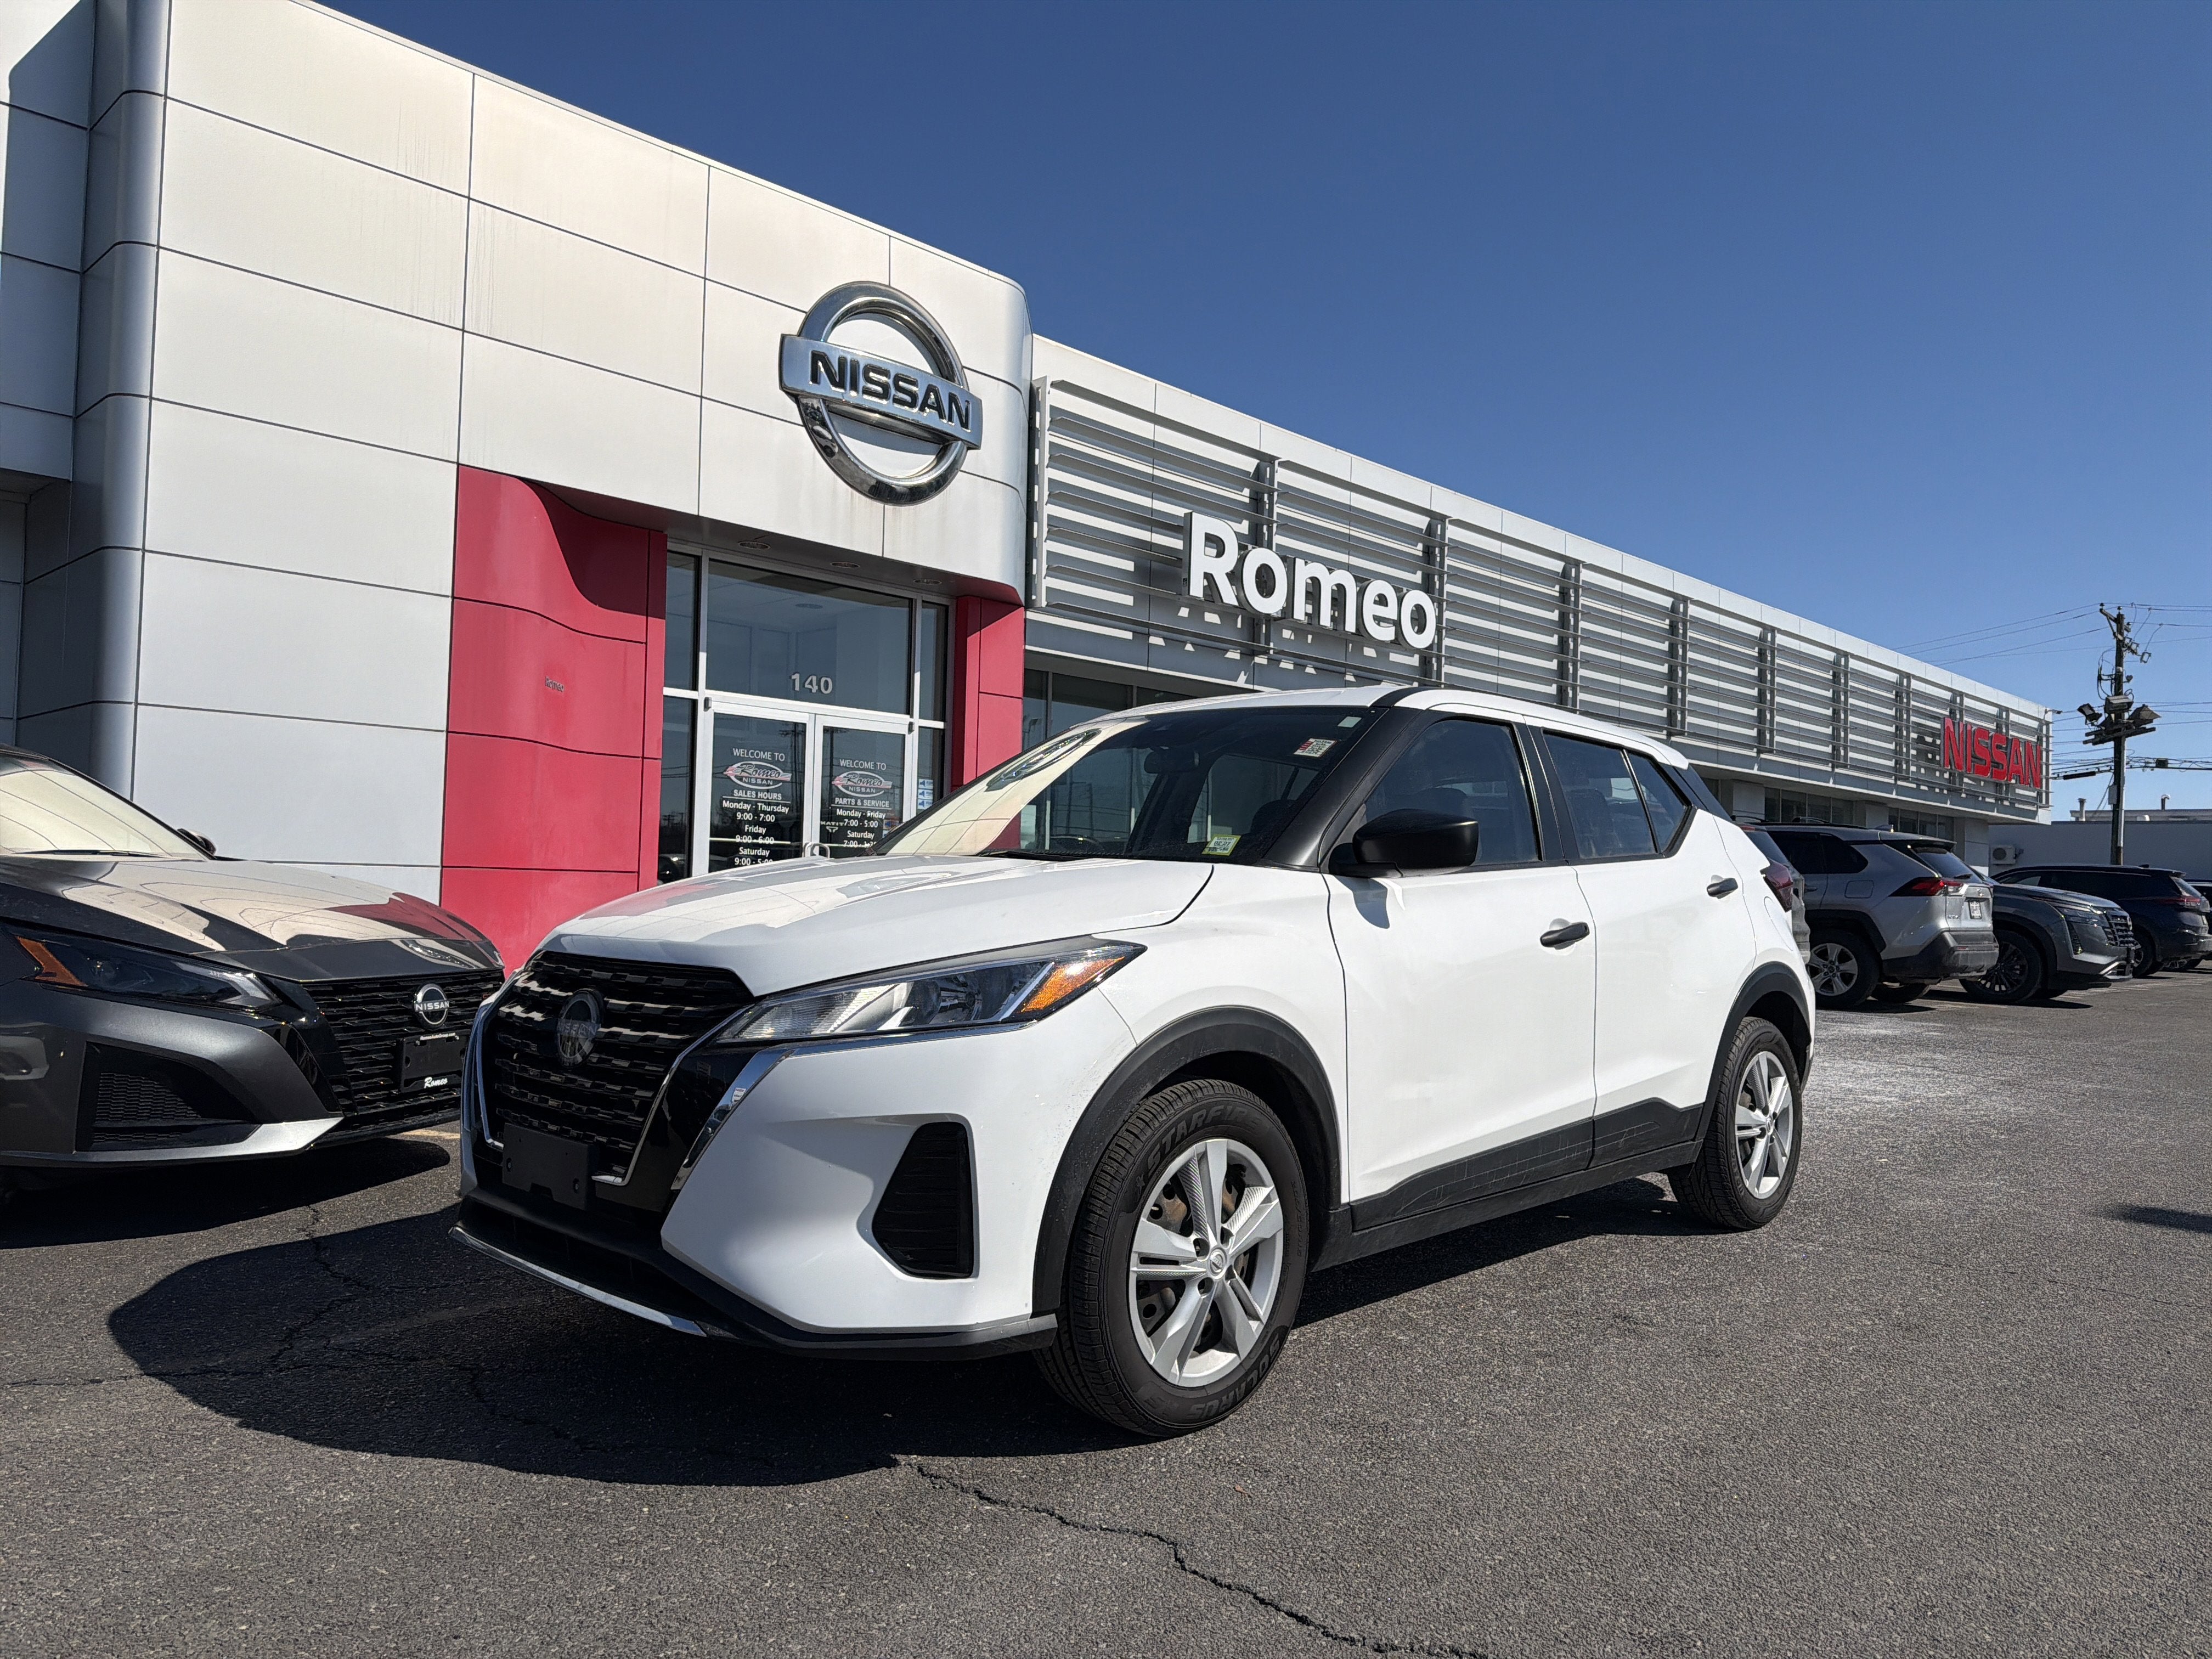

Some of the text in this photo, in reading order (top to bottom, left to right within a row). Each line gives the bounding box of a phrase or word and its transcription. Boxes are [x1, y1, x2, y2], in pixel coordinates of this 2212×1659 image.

[809, 349, 971, 432] NISSAN
[1187, 511, 1437, 649] Romeo
[545, 676, 565, 692] Romeo
[791, 673, 833, 694] 140
[733, 748, 785, 761] WELCOME TO
[1943, 717, 2041, 789] NISSAN
[739, 763, 781, 778] Romeo
[839, 759, 887, 770] WELCOME TO
[742, 777, 773, 785] NISSAN
[843, 772, 882, 786] Romeo
[733, 789, 782, 800] SALES HOURS
[723, 800, 751, 811] Monday
[757, 803, 789, 814] Thursday
[835, 797, 855, 805] PARTS
[863, 799, 890, 808] SERVICE
[736, 812, 753, 820] 9:00
[759, 814, 775, 822] 7:00
[836, 808, 862, 818] Monday
[867, 810, 886, 819] Friday
[745, 825, 766, 834] Friday
[847, 830, 874, 840] Saturday
[736, 834, 752, 843] 9:00
[739, 847, 770, 857] Saturday
[415, 1001, 449, 1011] NISSAN
[557, 1020, 597, 1036] SSAN
[424, 1077, 448, 1088] Romeo
[1147, 1104, 1263, 1178] STARFIRE
[1186, 1332, 1280, 1420] SOLARUS
